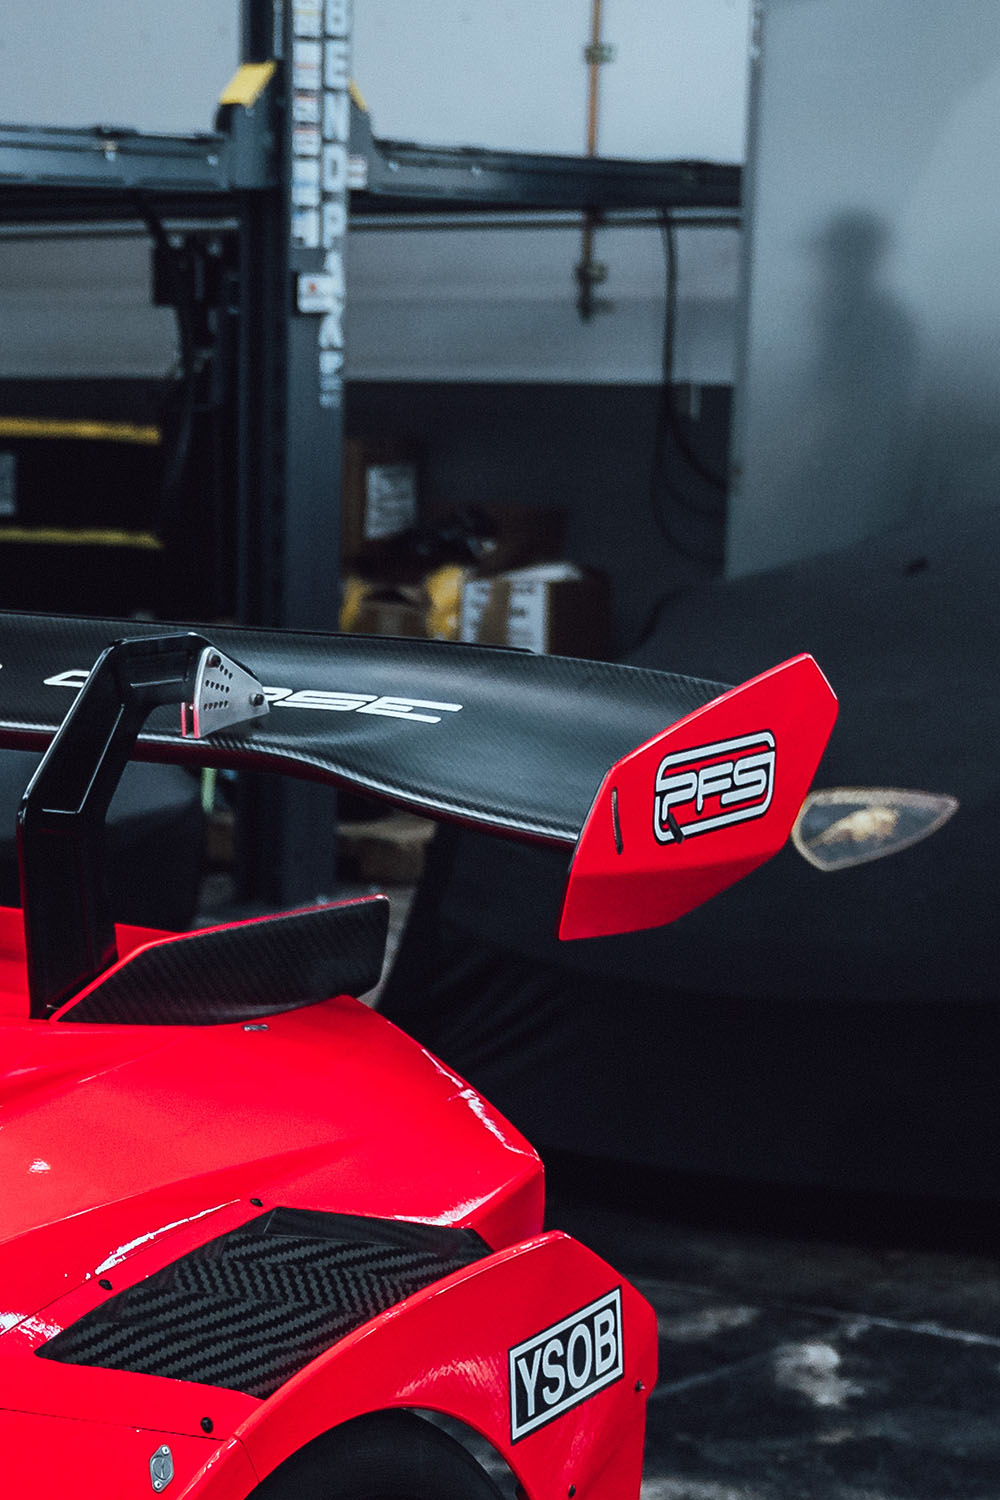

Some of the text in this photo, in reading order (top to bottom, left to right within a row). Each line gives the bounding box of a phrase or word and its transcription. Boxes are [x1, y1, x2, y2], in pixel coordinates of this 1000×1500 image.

[43, 668, 464, 724] CSE
[654, 747, 776, 828] PFS
[516, 1308, 618, 1418] YSOB
